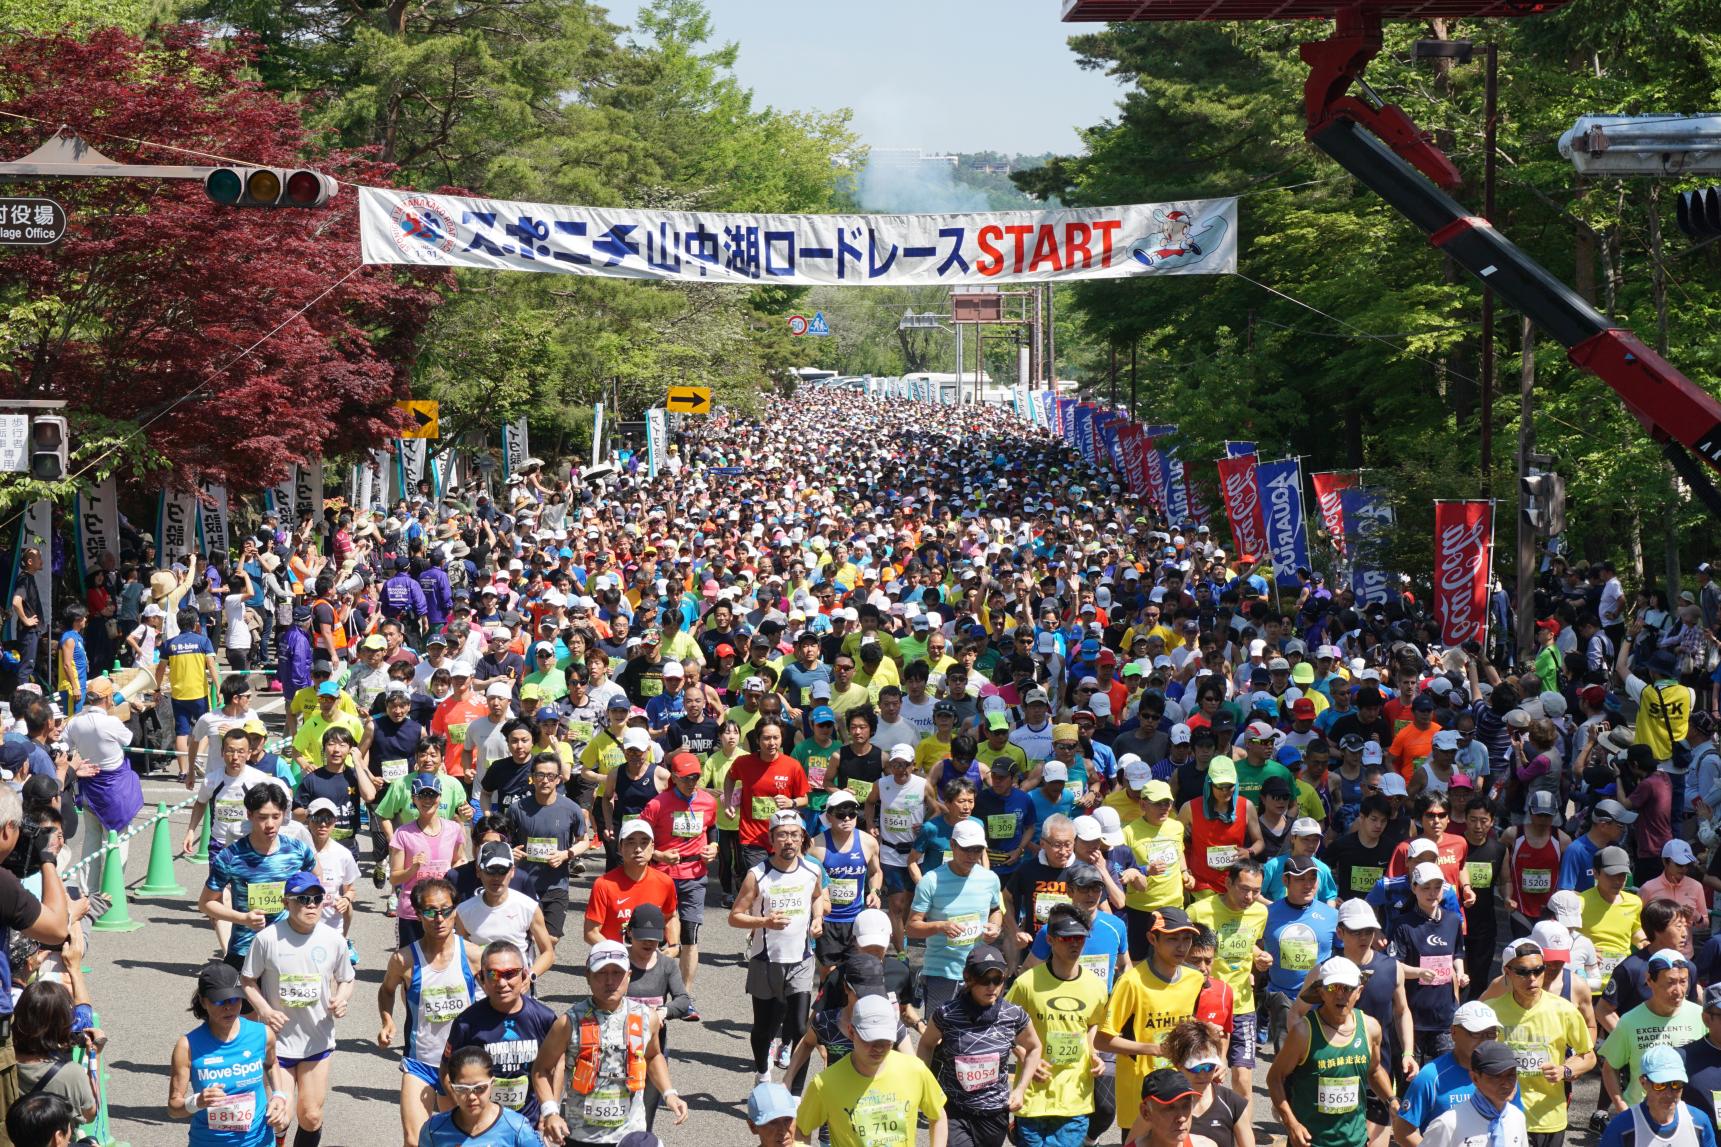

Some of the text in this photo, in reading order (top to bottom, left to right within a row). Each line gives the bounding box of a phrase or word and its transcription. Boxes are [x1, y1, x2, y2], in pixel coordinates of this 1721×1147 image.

[25, 227, 56, 239] Office
[461, 210, 970, 280] スポニチ山中湖ロードレース
[976, 219, 1122, 277] START
[889, 816, 908, 826] 5641
[997, 823, 1013, 832] 309
[1527, 878, 1549, 888] 5205
[779, 898, 802, 909] 5736
[1230, 939, 1247, 949] 460
[1295, 952, 1307, 963] 87
[433, 1000, 464, 1012] 5480
[1146, 1014, 1194, 1029] ATHLET
[1636, 1025, 1685, 1035] EXCELLENT
[1637, 1034, 1660, 1043] MADE
[484, 1040, 539, 1056] YOKOHAMA
[1059, 1045, 1078, 1056] 220
[966, 1069, 996, 1082] 8054
[1329, 1092, 1356, 1104] 5652
[219, 1109, 253, 1122] 8126
[595, 1105, 627, 1118] 5825
[873, 1121, 899, 1133] 710
